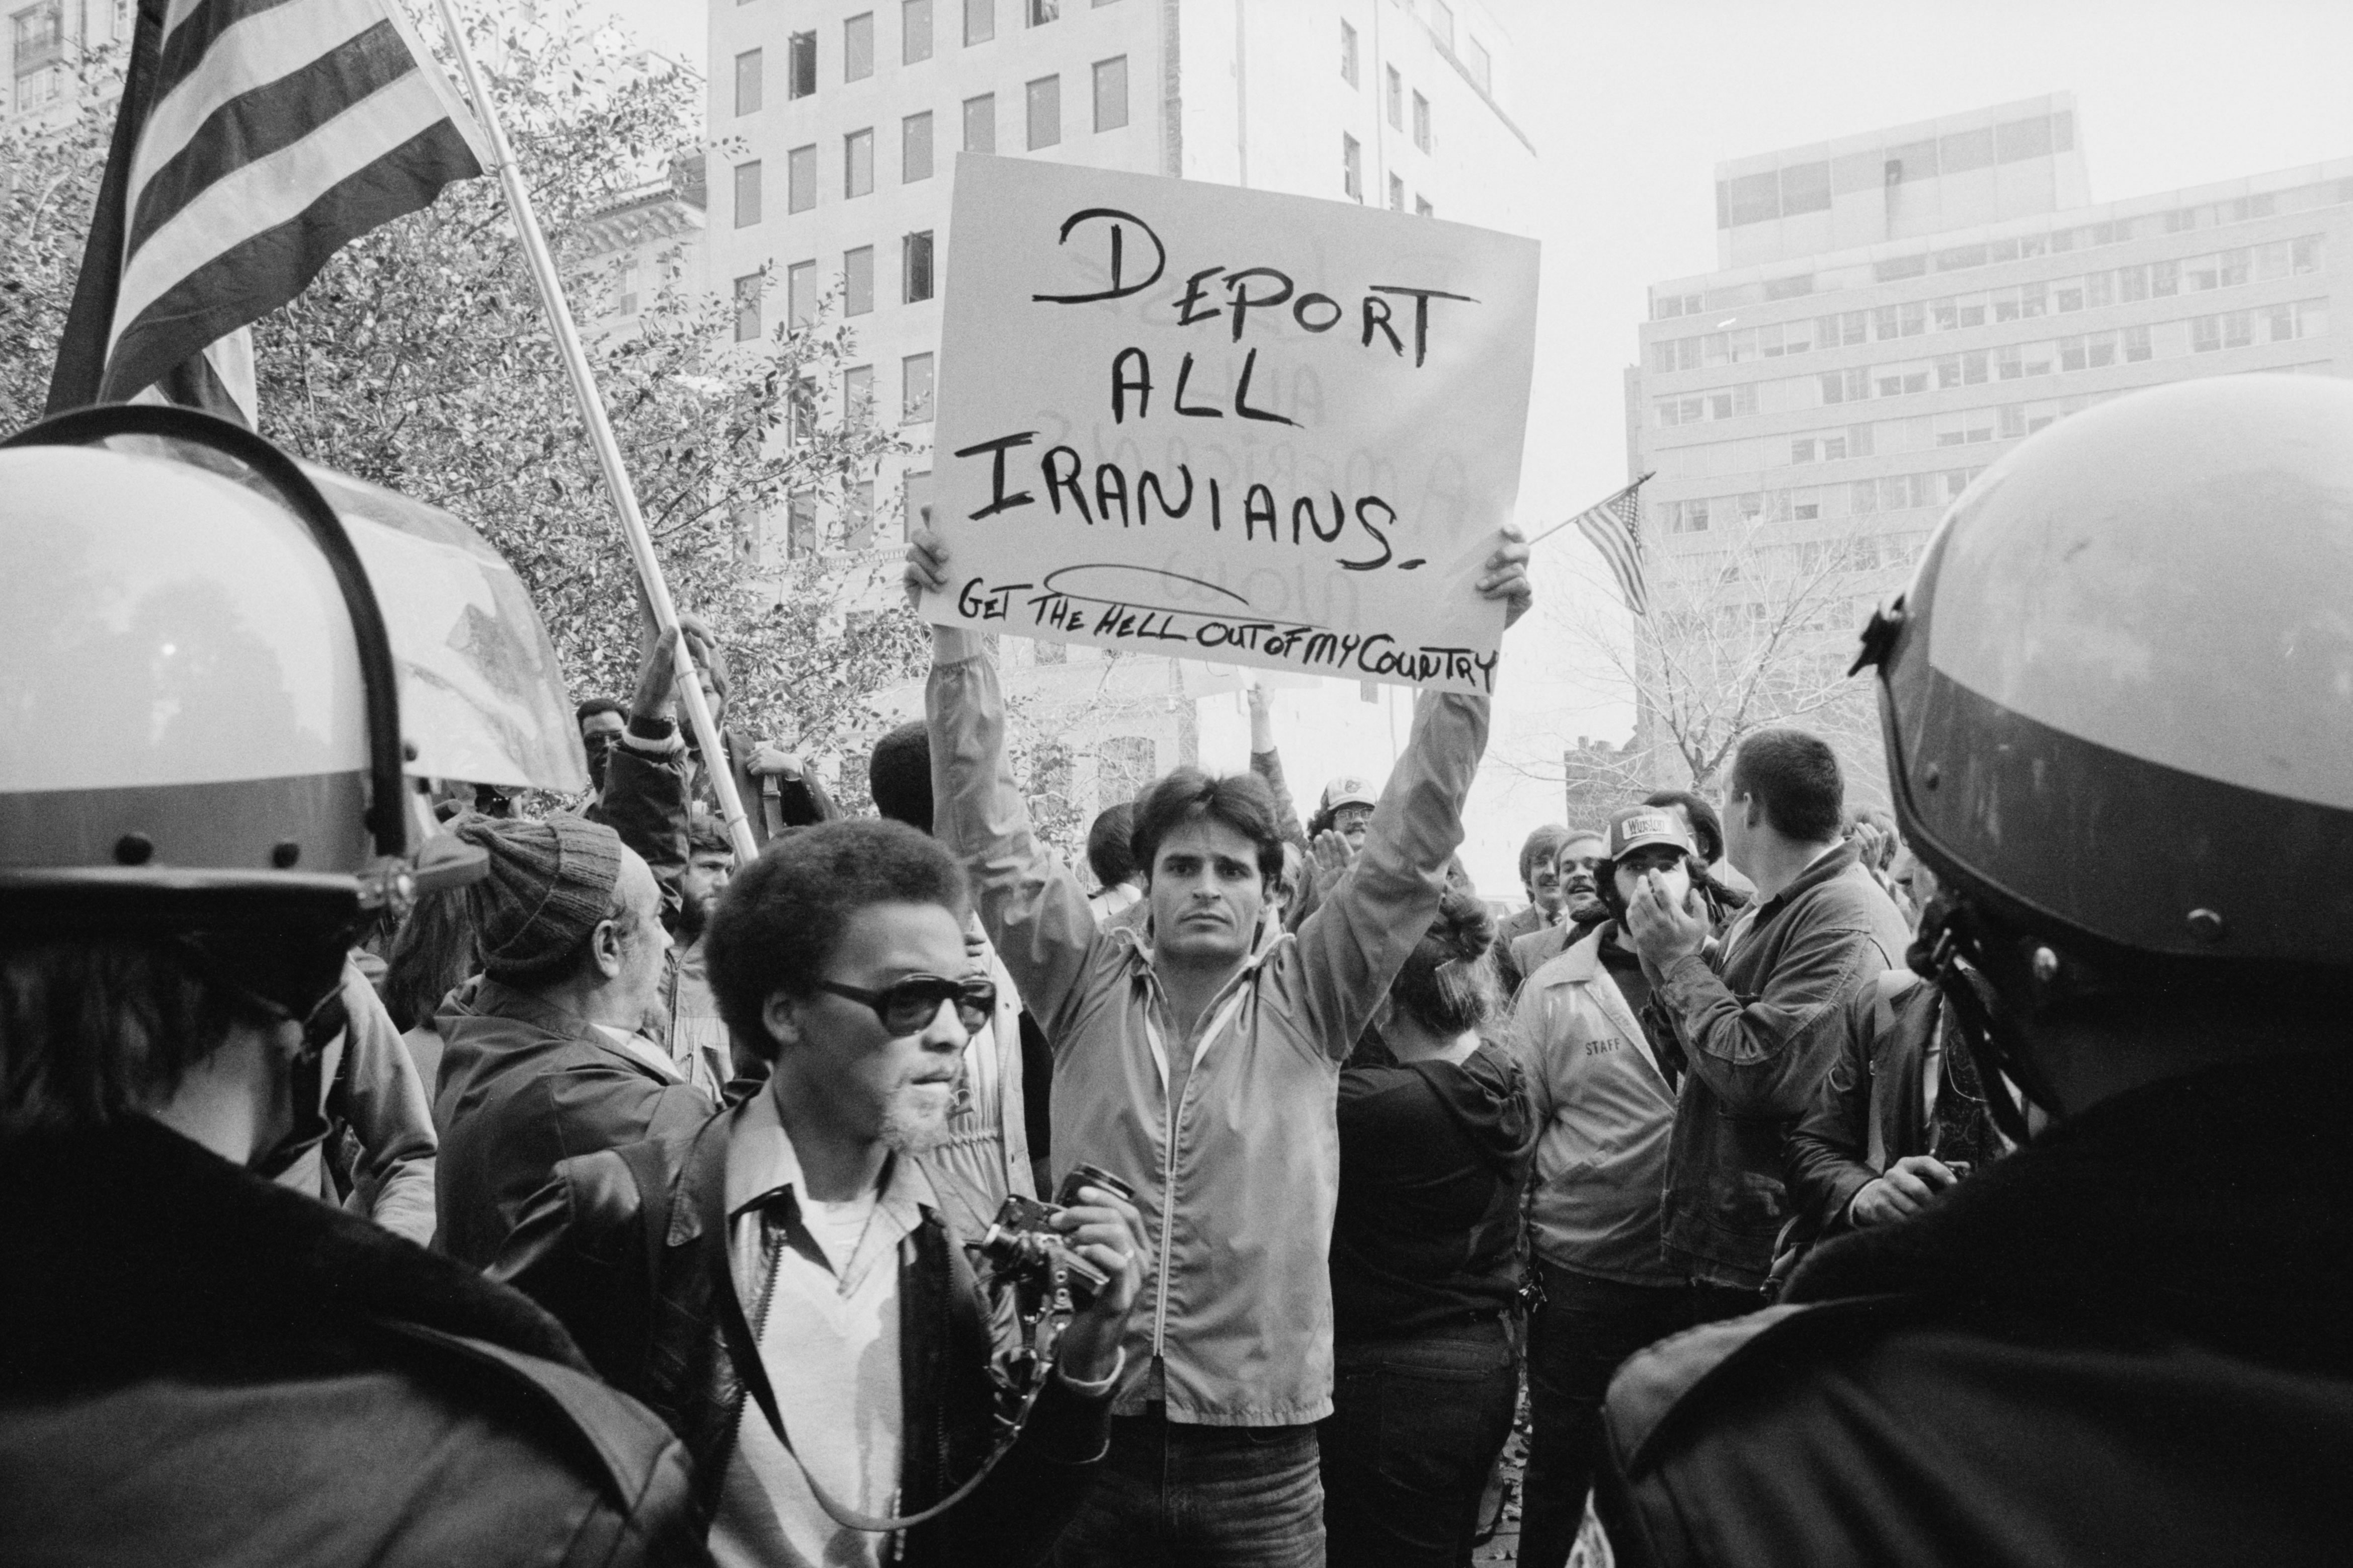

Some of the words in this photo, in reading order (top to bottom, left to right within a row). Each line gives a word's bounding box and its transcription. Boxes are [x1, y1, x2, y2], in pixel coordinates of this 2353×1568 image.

[1032, 208, 1482, 368] DEPORT
[1112, 346, 1305, 428] ALL
[958, 577, 1033, 621] GET
[1027, 592, 1084, 632] THE
[1093, 603, 1188, 642] HELL
[1196, 621, 1275, 649] OUT
[1302, 632, 1360, 669] MY
[1357, 633, 1500, 694] COUNTRY
[1628, 816, 1665, 832] Winston
[1585, 1038, 1620, 1055] STAFF
